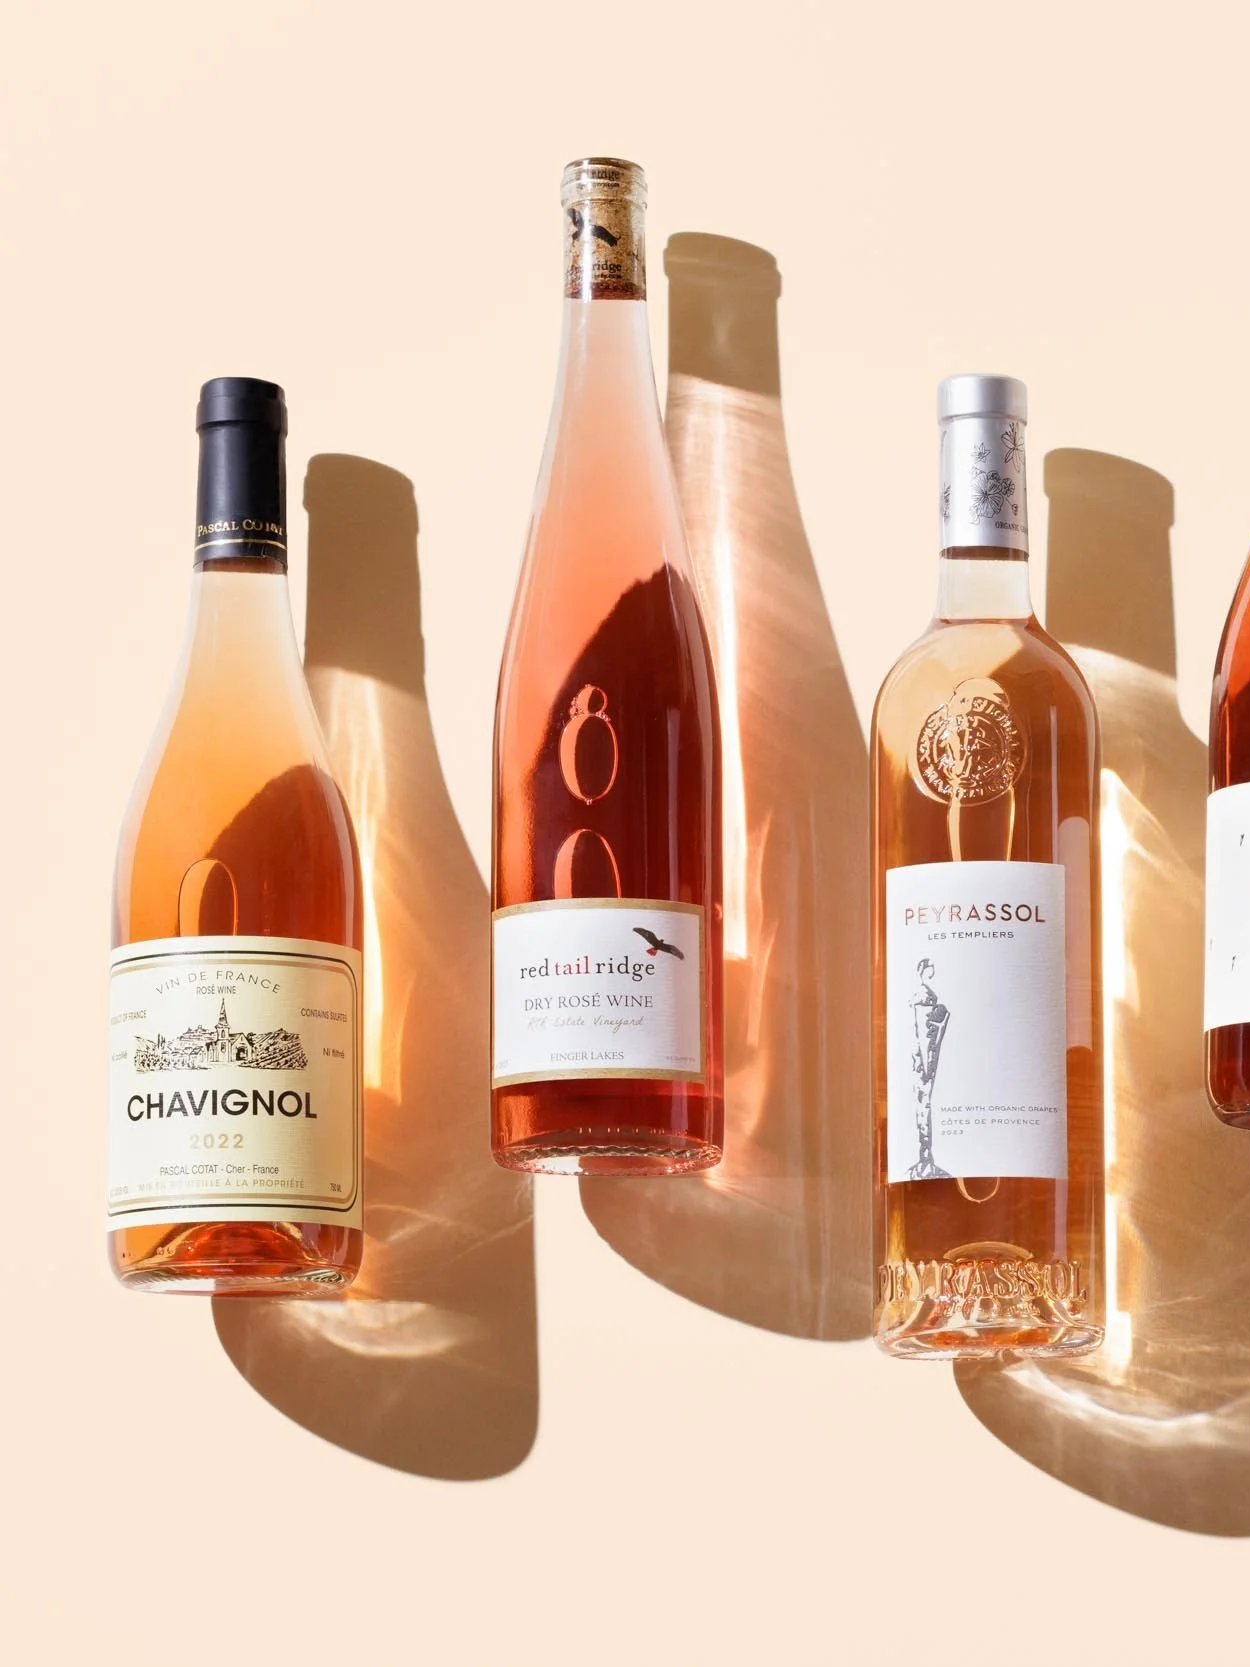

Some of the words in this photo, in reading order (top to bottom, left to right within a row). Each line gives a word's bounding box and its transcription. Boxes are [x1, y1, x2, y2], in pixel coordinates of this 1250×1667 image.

[197, 521, 239, 537] PASCAL
[904, 903, 1046, 926] PEYRASSOL
[927, 931, 947, 941] LES
[951, 930, 1015, 940] TEMPLIERS
[520, 958, 549, 979] red
[555, 956, 590, 975] tail
[595, 956, 655, 982] ridge
[155, 977, 180, 994] VIN
[188, 971, 208, 983] DE
[216, 970, 281, 994] FRANCE
[196, 984, 215, 995] ROSÉ
[216, 985, 237, 995] WINE
[524, 996, 553, 1011] DRY
[558, 993, 601, 1009] ROSÉ
[606, 995, 653, 1008] WINE
[301, 1008, 329, 1019] CONTAINS
[552, 1016, 585, 1028] Estate
[593, 1015, 644, 1036] Vineyard
[550, 1052, 588, 1062] FINGER
[590, 1051, 625, 1061] LAKES
[127, 1089, 317, 1121] CHAVIGNOL
[940, 1105, 963, 1113] MADE
[1028, 1105, 1058, 1113] GRAPES
[940, 1117, 971, 1126] CÔTES
[189, 1133, 244, 1149] 2022
[160, 1165, 190, 1176] PASCAL
[191, 1164, 218, 1175] COTAT
[226, 1164, 245, 1174] Cher
[253, 1164, 279, 1174] France
[236, 1179, 249, 1187] LA
[253, 1178, 304, 1189] PROPRIÉTÉ
